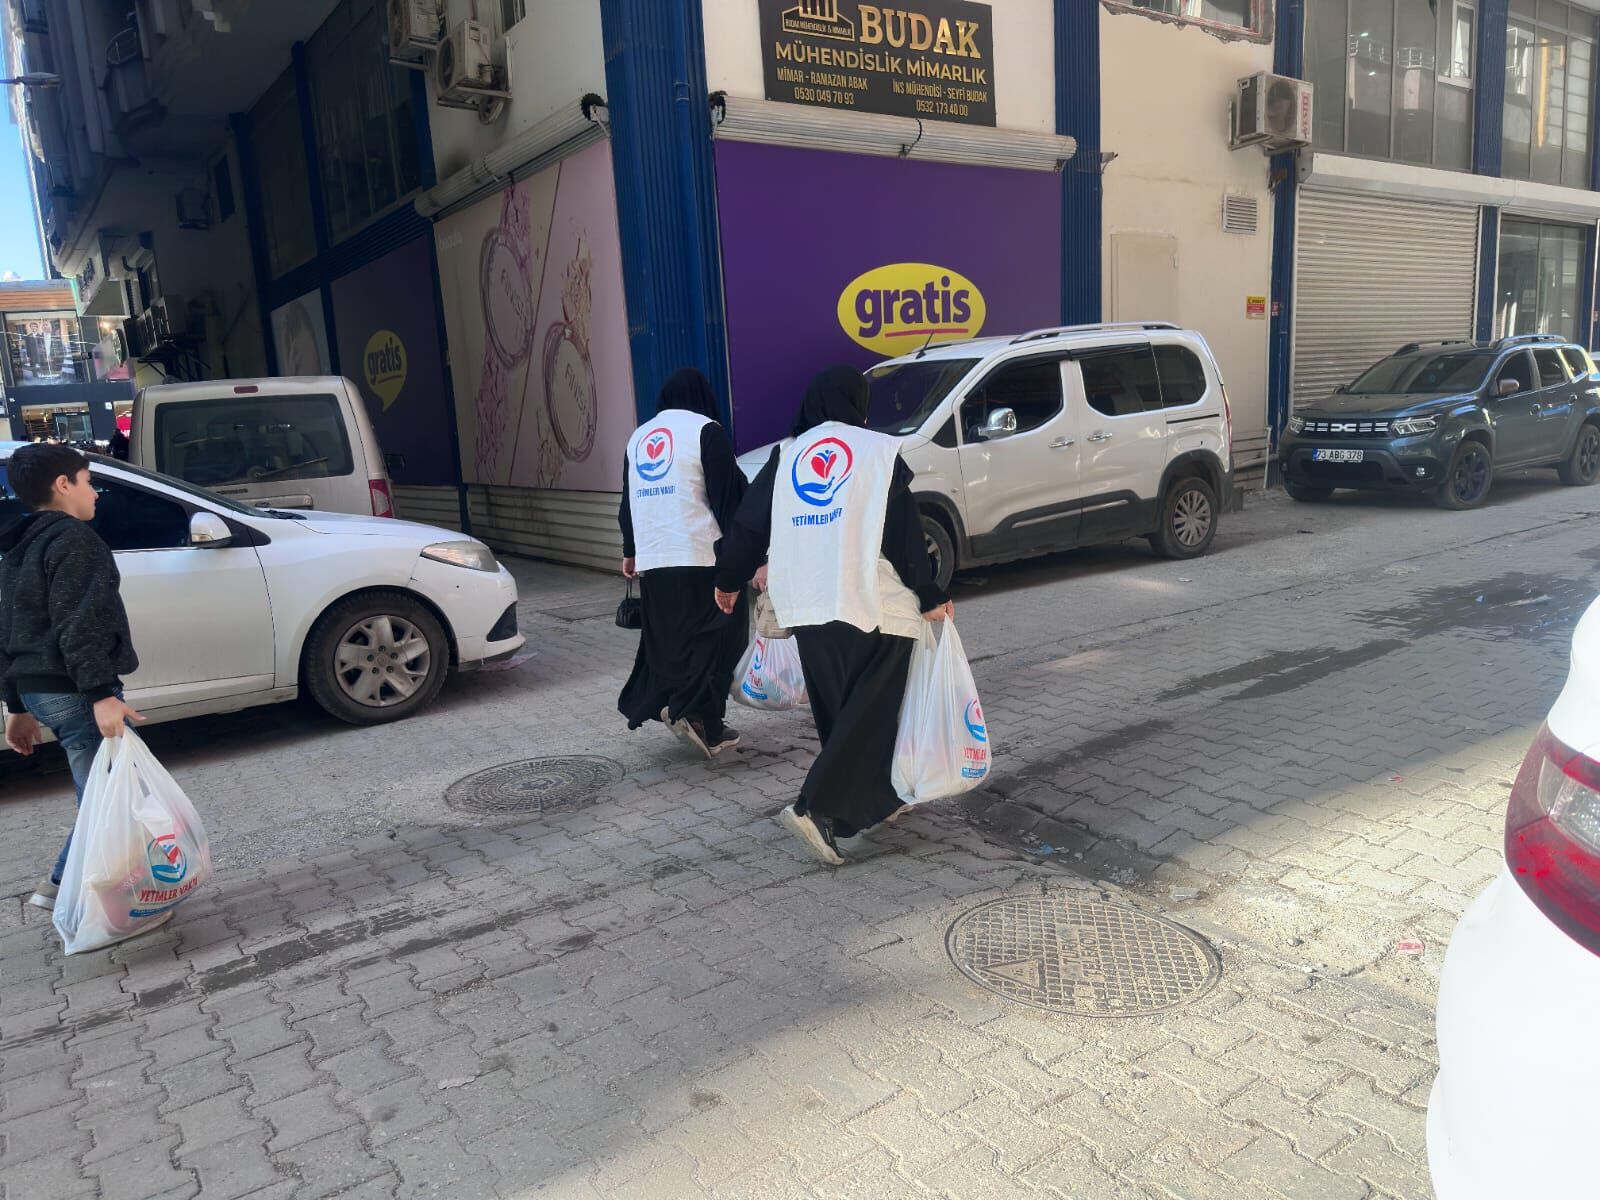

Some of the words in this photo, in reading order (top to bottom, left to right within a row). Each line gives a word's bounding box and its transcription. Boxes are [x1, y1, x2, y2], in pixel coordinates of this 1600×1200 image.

[857, 4, 982, 59] BUDAK
[775, 40, 902, 75] MÜHENDİSLİK
[906, 56, 987, 85] MİMARLIK
[776, 66, 804, 83] MİMAR
[810, 71, 847, 88] RAMAZAN
[848, 75, 868, 90] ABAK
[794, 87, 815, 101] 0530
[816, 89, 831, 103] 049
[833, 91, 843, 104] 70
[844, 92, 854, 105] 93
[947, 87, 966, 100] SEYFİ
[966, 90, 988, 103] BUDAK
[916, 100, 934, 112] 0532
[935, 102, 948, 114] 173
[949, 103, 958, 115] 40
[959, 105, 969, 117] 00
[855, 275, 971, 338] gratis
[367, 337, 402, 386] gratis
[1347, 451, 1362, 460] 378
[792, 513, 828, 527] YETİMLER
